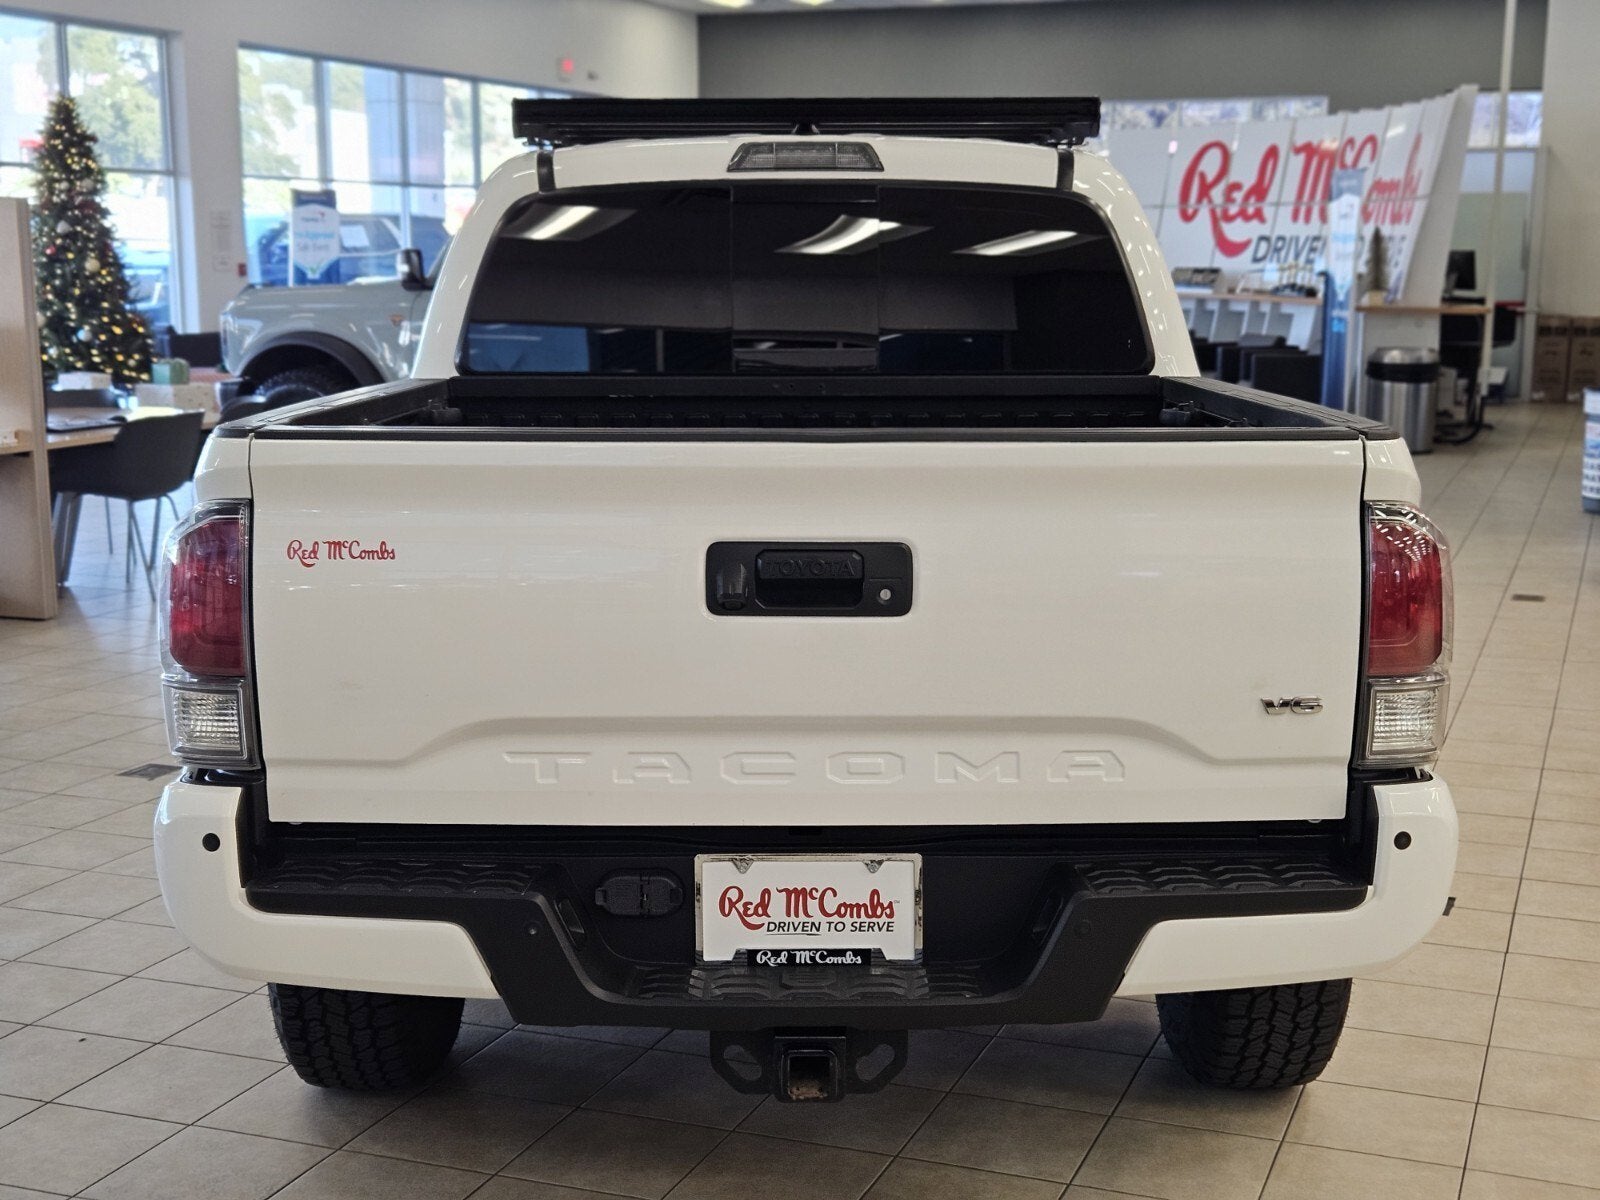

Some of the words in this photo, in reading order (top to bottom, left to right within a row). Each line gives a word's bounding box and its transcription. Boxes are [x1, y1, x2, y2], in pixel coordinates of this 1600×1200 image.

[1179, 141, 1280, 258] Red
[287, 539, 319, 568] Red
[322, 539, 396, 560] McCombs
[766, 558, 856, 577] TOYOTA
[1260, 697, 1323, 715] V6
[503, 750, 1126, 785] TACOMA
[718, 885, 771, 930] Red
[776, 886, 895, 919] McCombs
[766, 921, 821, 933] DRIVEN
[826, 921, 846, 933] TO
[850, 921, 894, 933] SERVE
[756, 950, 788, 967] Red
[790, 949, 862, 965] McCombs
